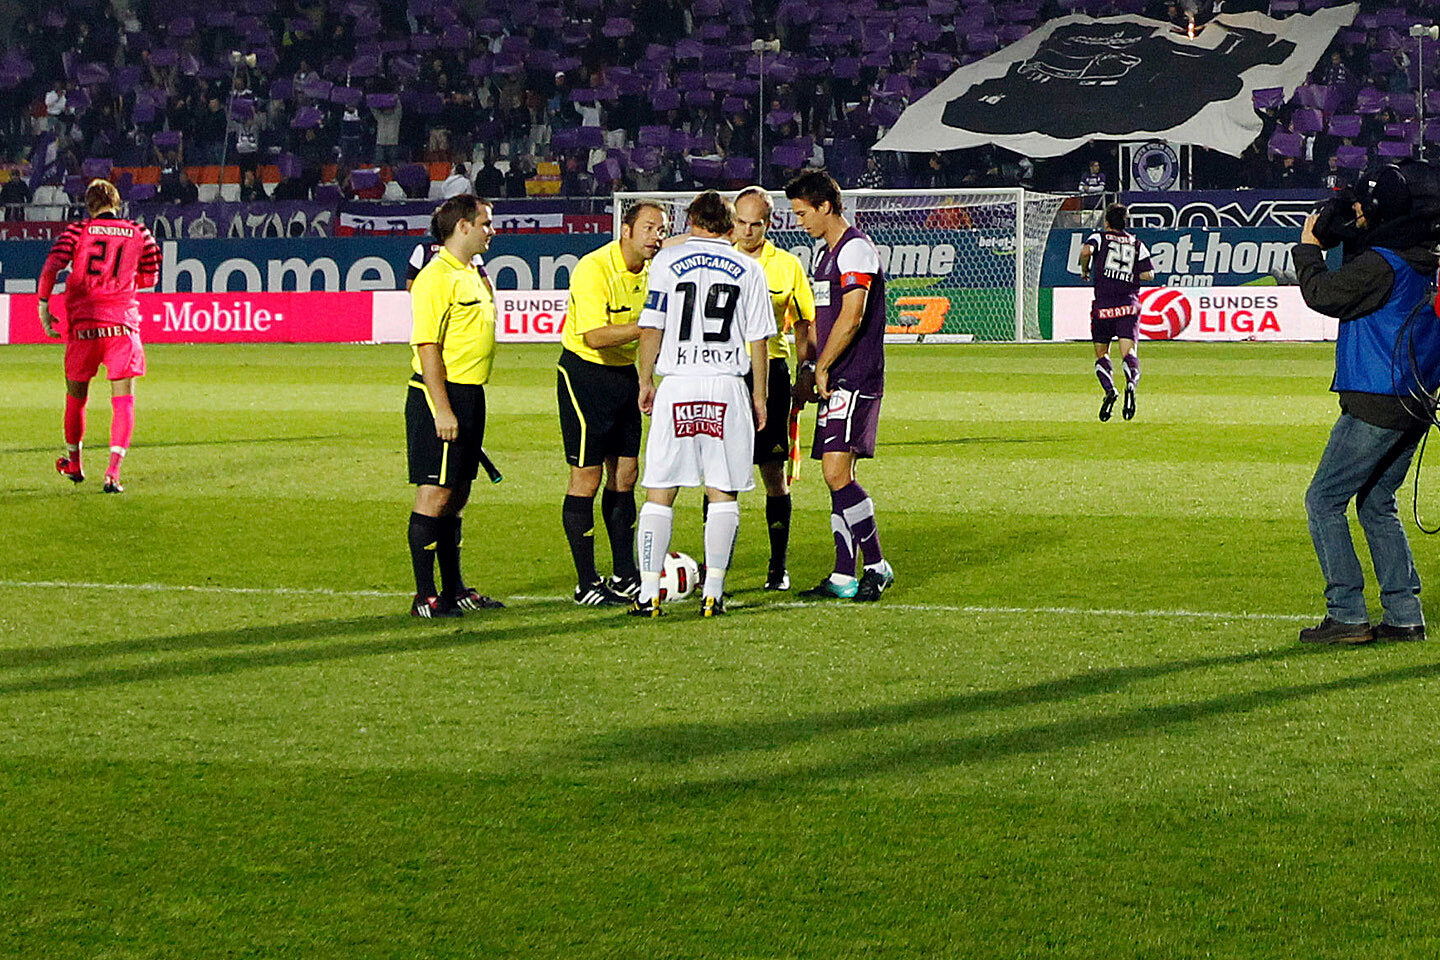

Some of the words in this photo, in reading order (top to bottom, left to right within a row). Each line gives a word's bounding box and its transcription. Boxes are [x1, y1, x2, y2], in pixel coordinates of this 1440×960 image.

[88, 224, 134, 238] GENERALI
[87, 240, 124, 278] 21
[672, 252, 744, 278] PUNTIGAMER
[1103, 240, 1137, 274] 29
[674, 281, 741, 343] 19
[1199, 296, 1279, 309] BUNDES
[163, 300, 273, 332] Mobile
[1199, 311, 1282, 333] LIGA
[677, 346, 741, 367] kienzl
[675, 404, 725, 422] KLEINE
